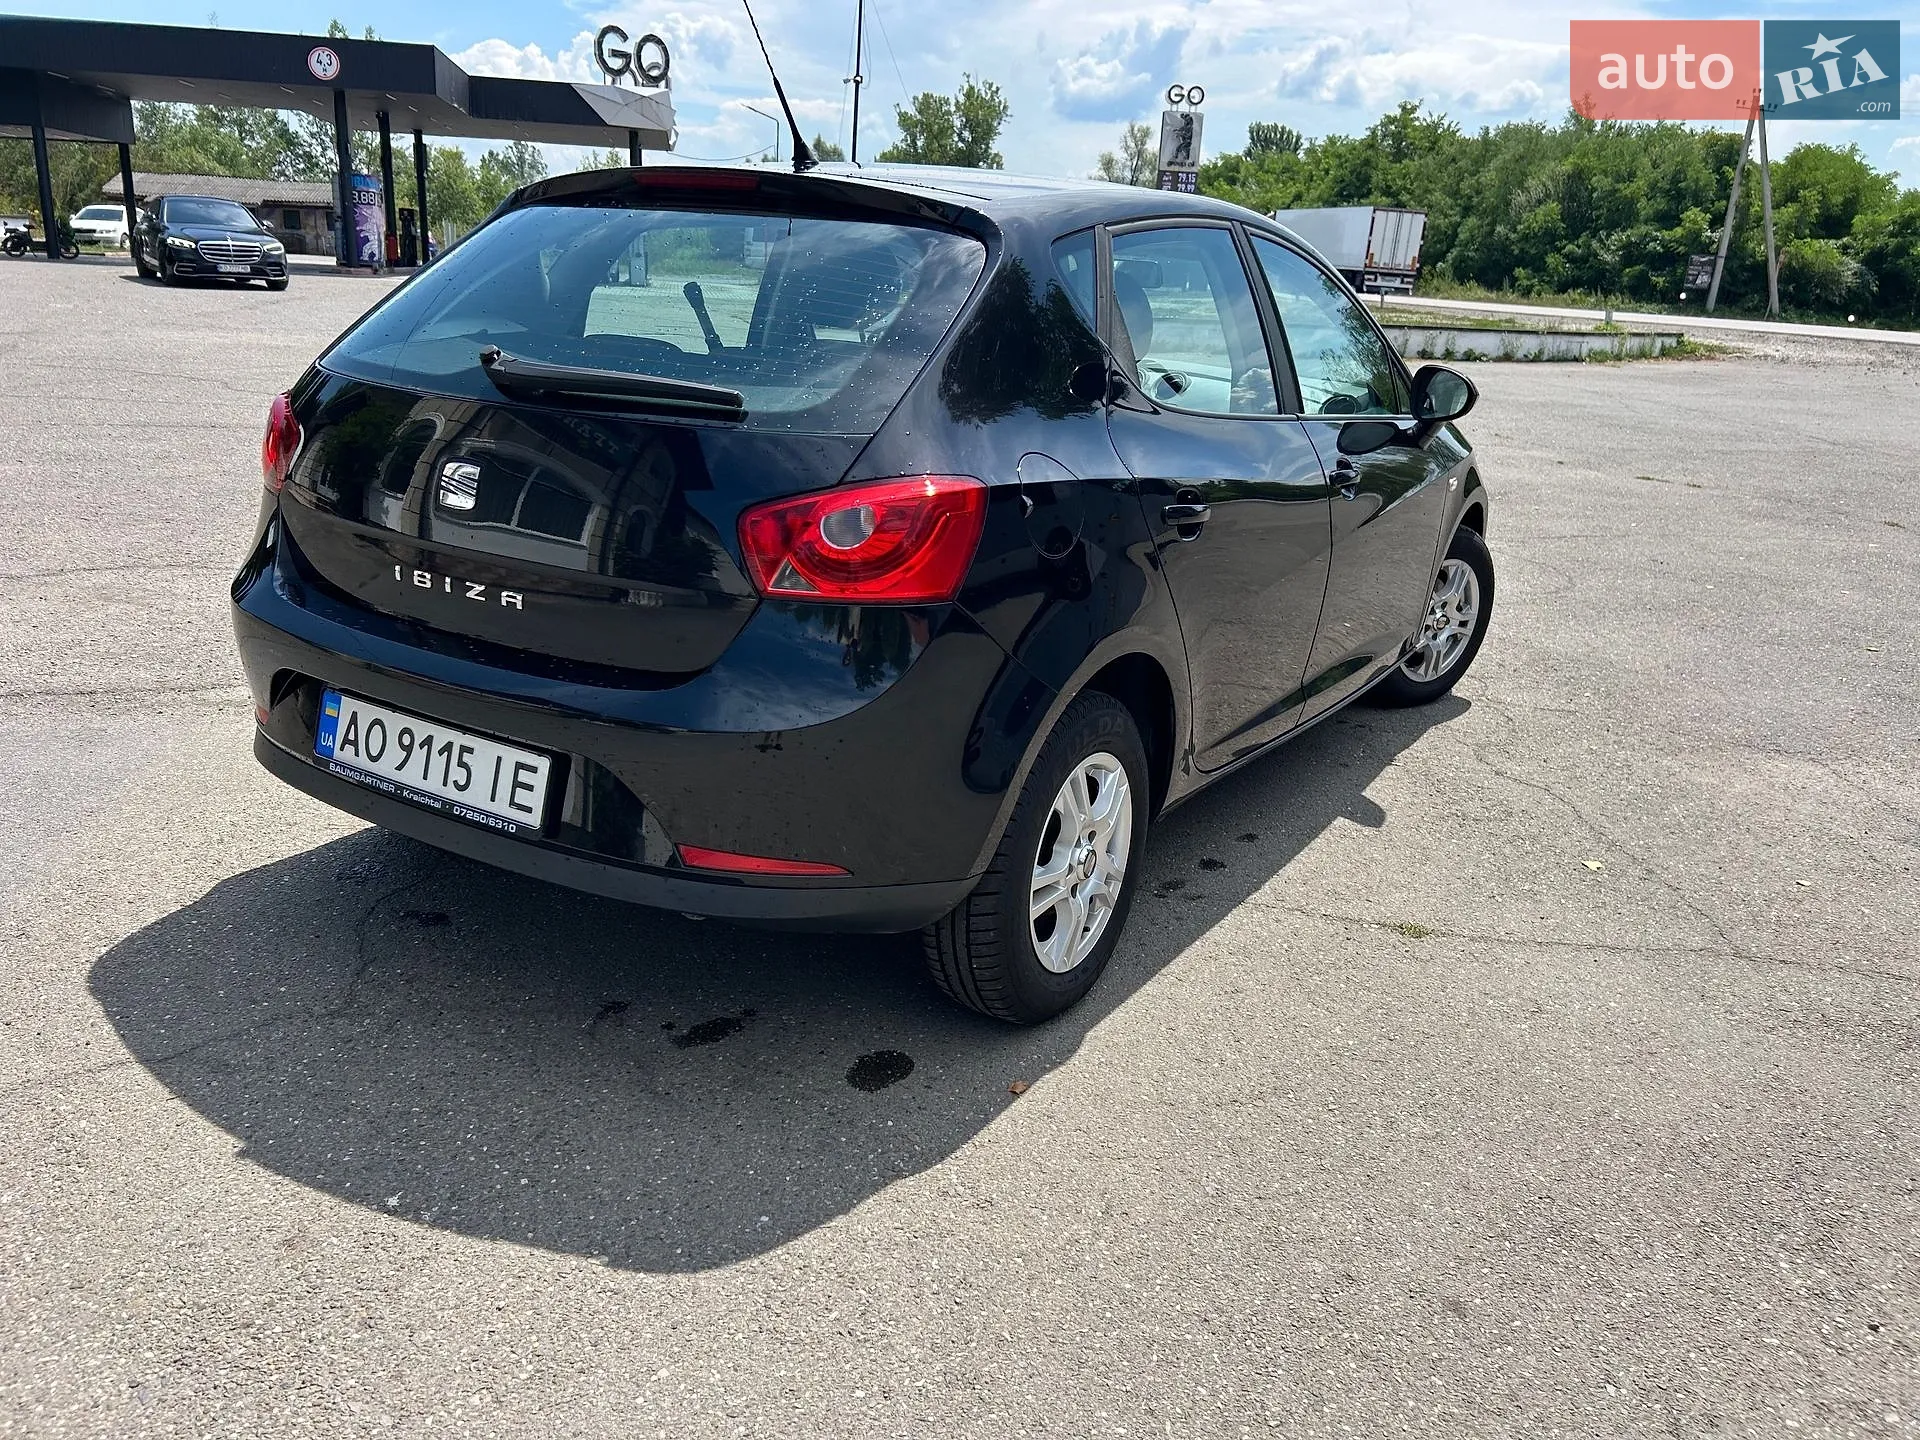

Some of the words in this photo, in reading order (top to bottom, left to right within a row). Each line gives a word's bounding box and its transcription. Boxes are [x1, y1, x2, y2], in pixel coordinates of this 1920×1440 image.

[594, 24, 670, 84] GO
[1167, 84, 1205, 105] GO
[394, 564, 523, 610] IBIZA
[321, 731, 334, 749] UA
[339, 710, 387, 763] AO
[394, 726, 474, 792] 9115
[489, 755, 539, 814] IE
[453, 806, 517, 833] 07250/6310
